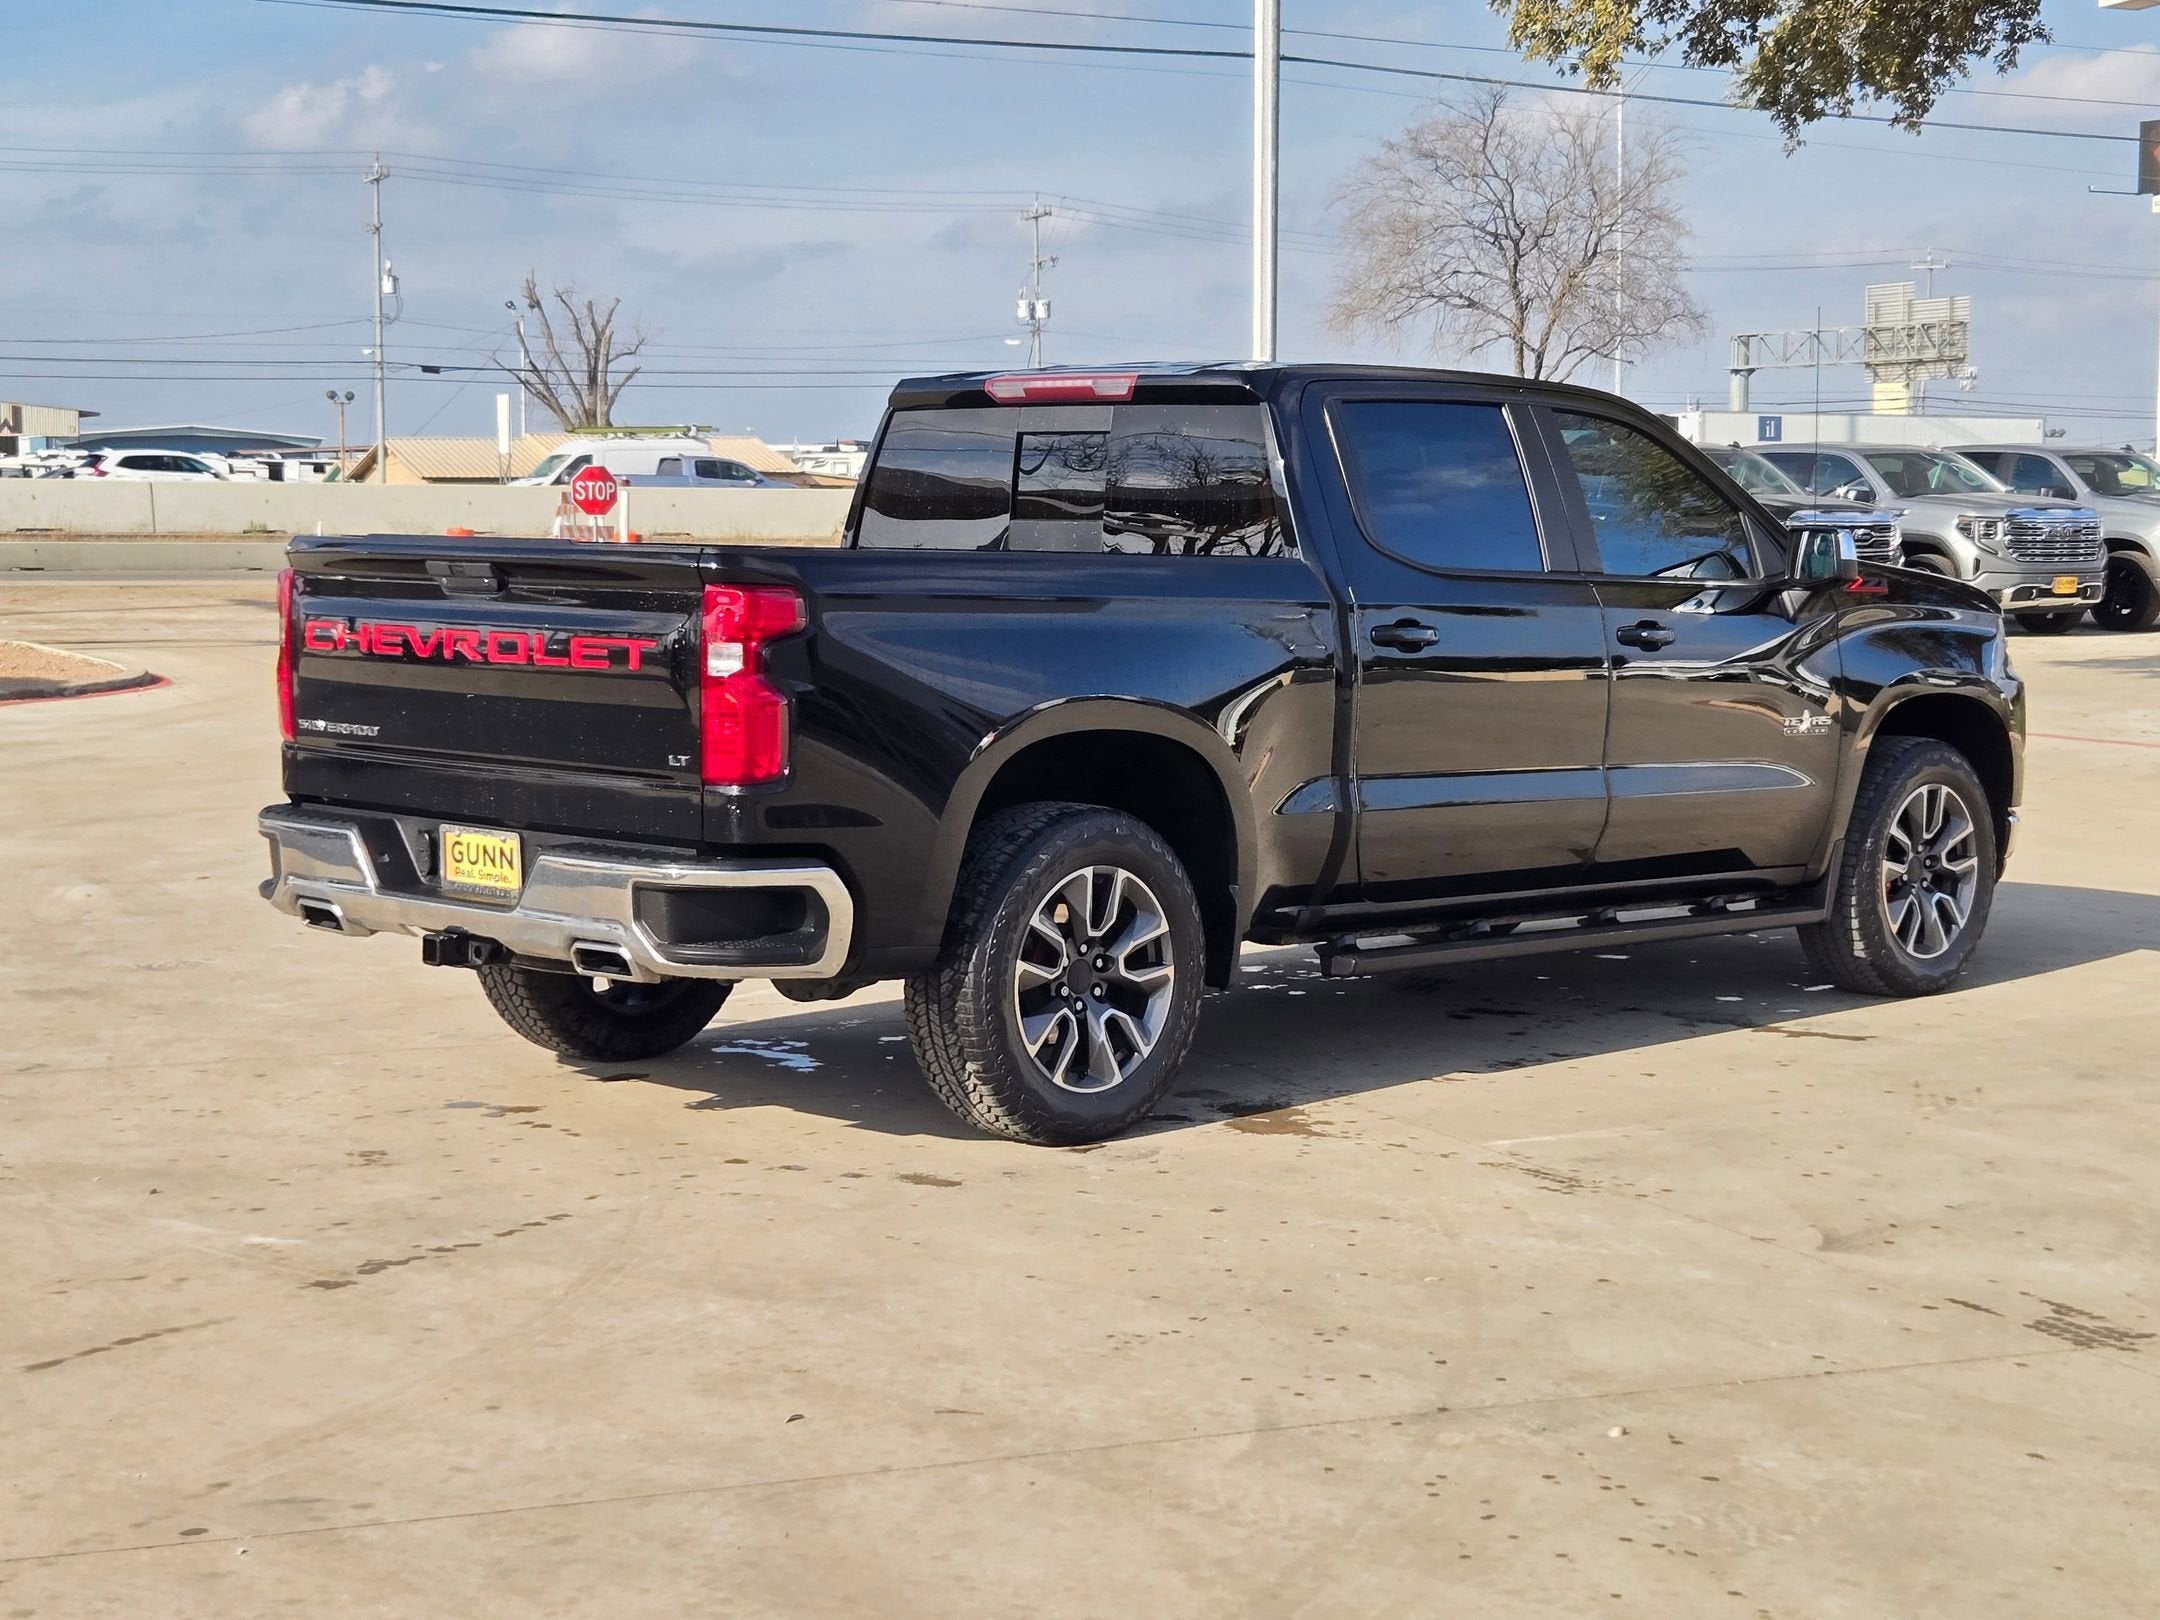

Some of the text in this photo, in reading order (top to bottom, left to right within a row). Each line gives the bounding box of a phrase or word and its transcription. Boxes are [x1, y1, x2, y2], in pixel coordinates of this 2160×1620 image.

[575, 480, 616, 501] STOP
[304, 620, 657, 671] CHEVROLET
[1783, 711, 1832, 730] TEXAS
[668, 755, 690, 766] LT
[451, 840, 514, 870] GUNN
